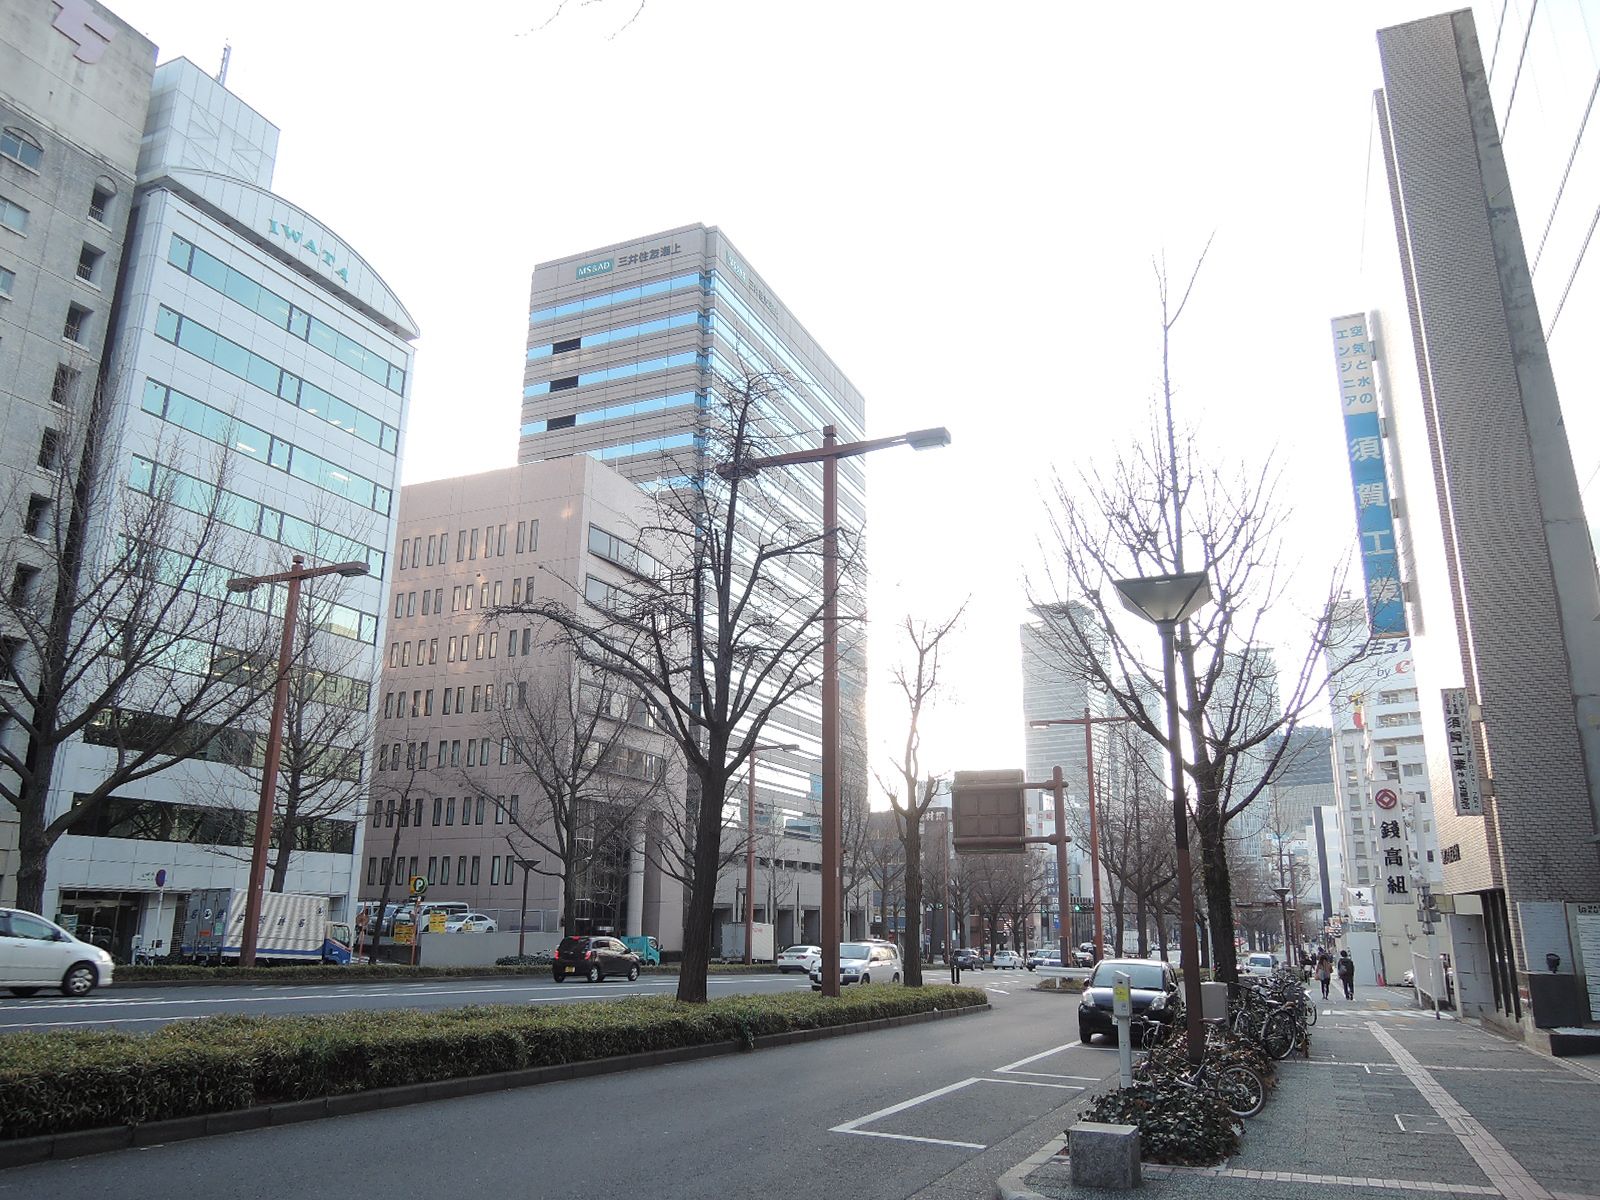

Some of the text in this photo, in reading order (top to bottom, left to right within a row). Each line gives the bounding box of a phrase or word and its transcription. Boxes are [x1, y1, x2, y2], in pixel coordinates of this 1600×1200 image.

[268, 218, 349, 284] IWATA
[578, 260, 610, 276] MS&AD
[617, 242, 682, 268] 三井住友海上
[1336, 329, 1358, 406] エンジニア
[1349, 325, 1373, 404] 空気と水の
[1350, 434, 1400, 605] 須賀工業
[1376, 667, 1391, 677] by
